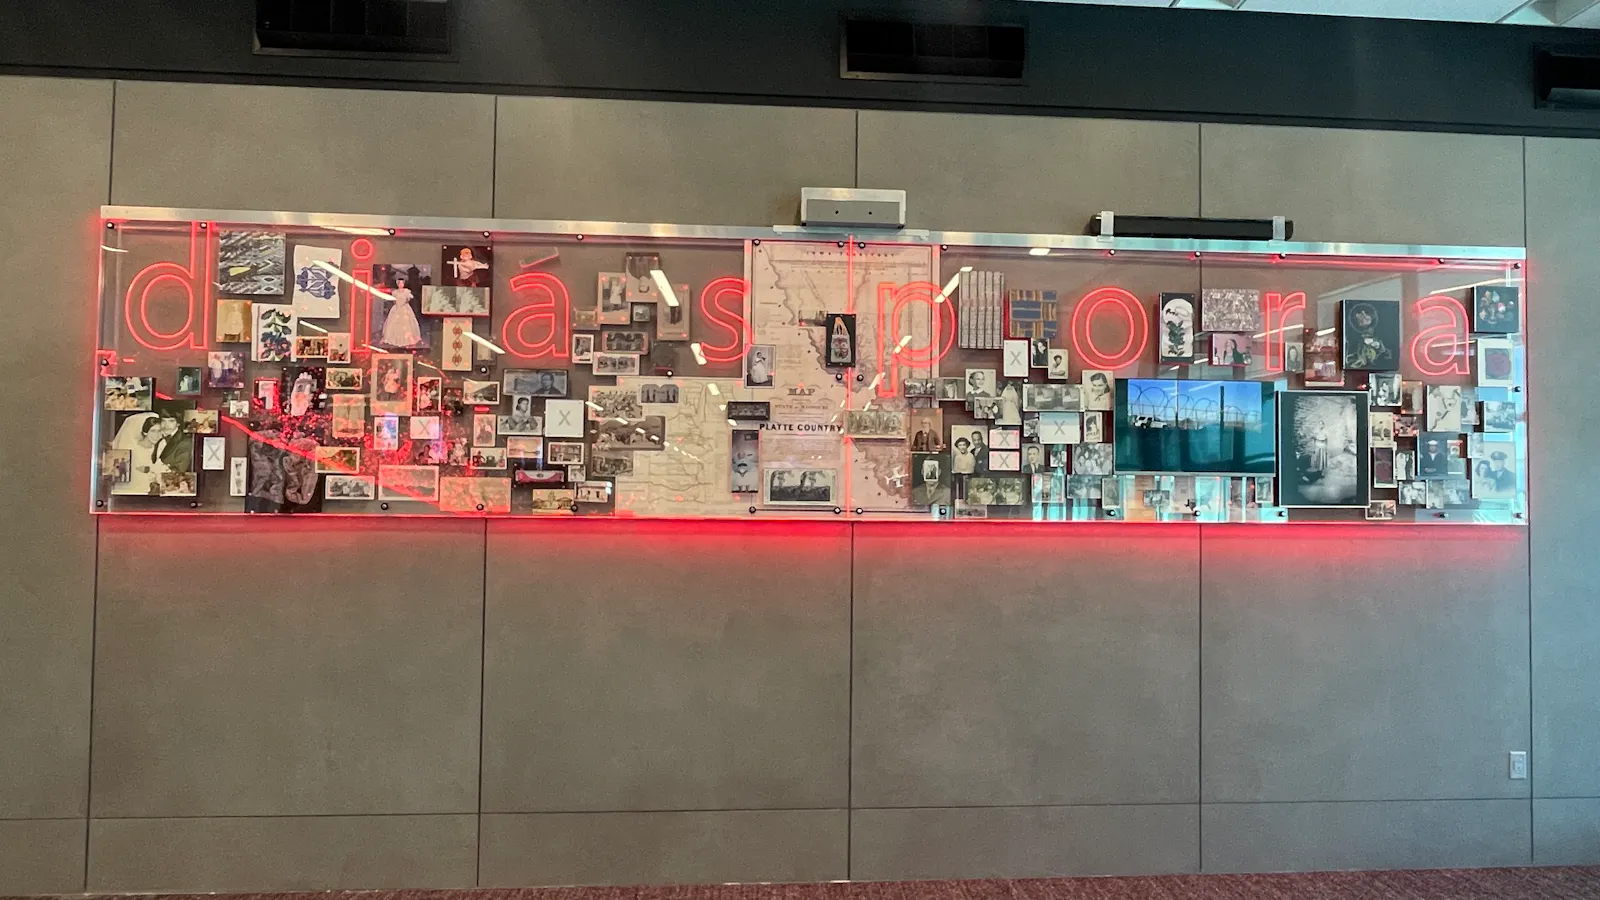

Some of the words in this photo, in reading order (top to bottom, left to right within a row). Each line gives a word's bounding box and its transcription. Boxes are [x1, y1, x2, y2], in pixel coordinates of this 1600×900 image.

[124, 221, 1471, 399] diaspora
[787, 387, 816, 396] MAP
[759, 423, 793, 431] PLATTE
[797, 424, 843, 432] COUNTRY
